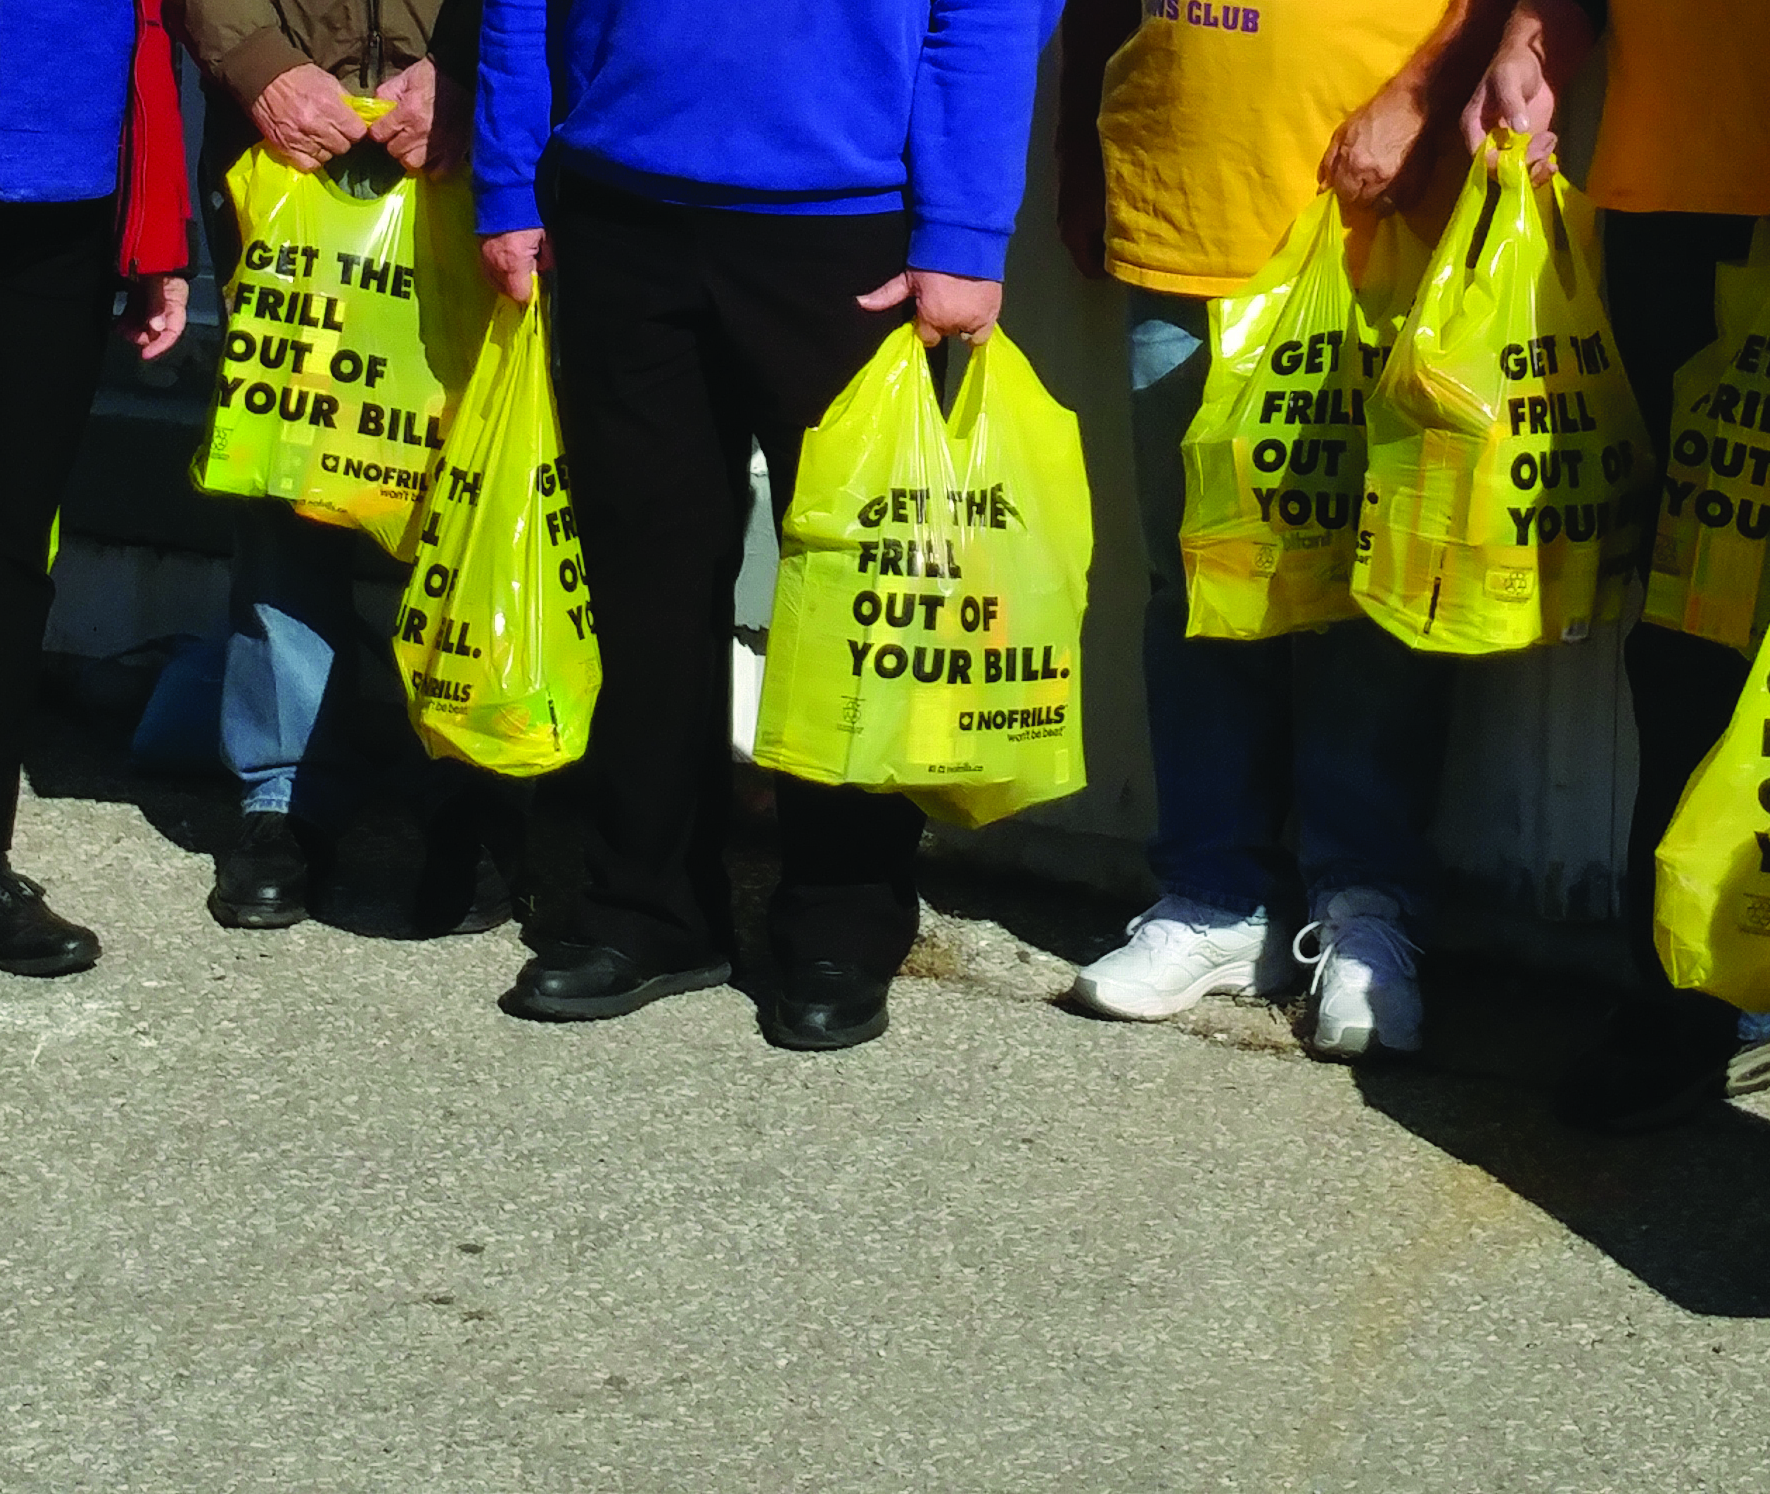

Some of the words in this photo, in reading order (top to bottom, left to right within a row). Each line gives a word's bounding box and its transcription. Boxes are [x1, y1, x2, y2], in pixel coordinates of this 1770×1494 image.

[1187, 0, 1259, 33] CLUB
[245, 239, 319, 279] GET
[337, 252, 415, 299] THE
[234, 282, 345, 333] FRILL
[226, 329, 314, 375] OUT
[329, 348, 387, 389] OF
[1271, 330, 1344, 376] GET
[1500, 335, 1558, 381] GET
[217, 373, 339, 430] YOUR
[1508, 391, 1597, 436] FRILL
[343, 457, 428, 491] NOFRIL
[1252, 438, 1347, 477] OUT
[1511, 449, 1583, 491] OUT
[857, 487, 930, 529] GET
[946, 482, 1027, 531] THE
[857, 538, 962, 579] FRILL
[852, 590, 945, 631] OUT
[960, 595, 999, 633] OF
[847, 639, 972, 684] YOUR
[984, 644, 1070, 683] BILL.
[976, 705, 1066, 731] NOFRILLS
[1031, 729, 1042, 739] be
